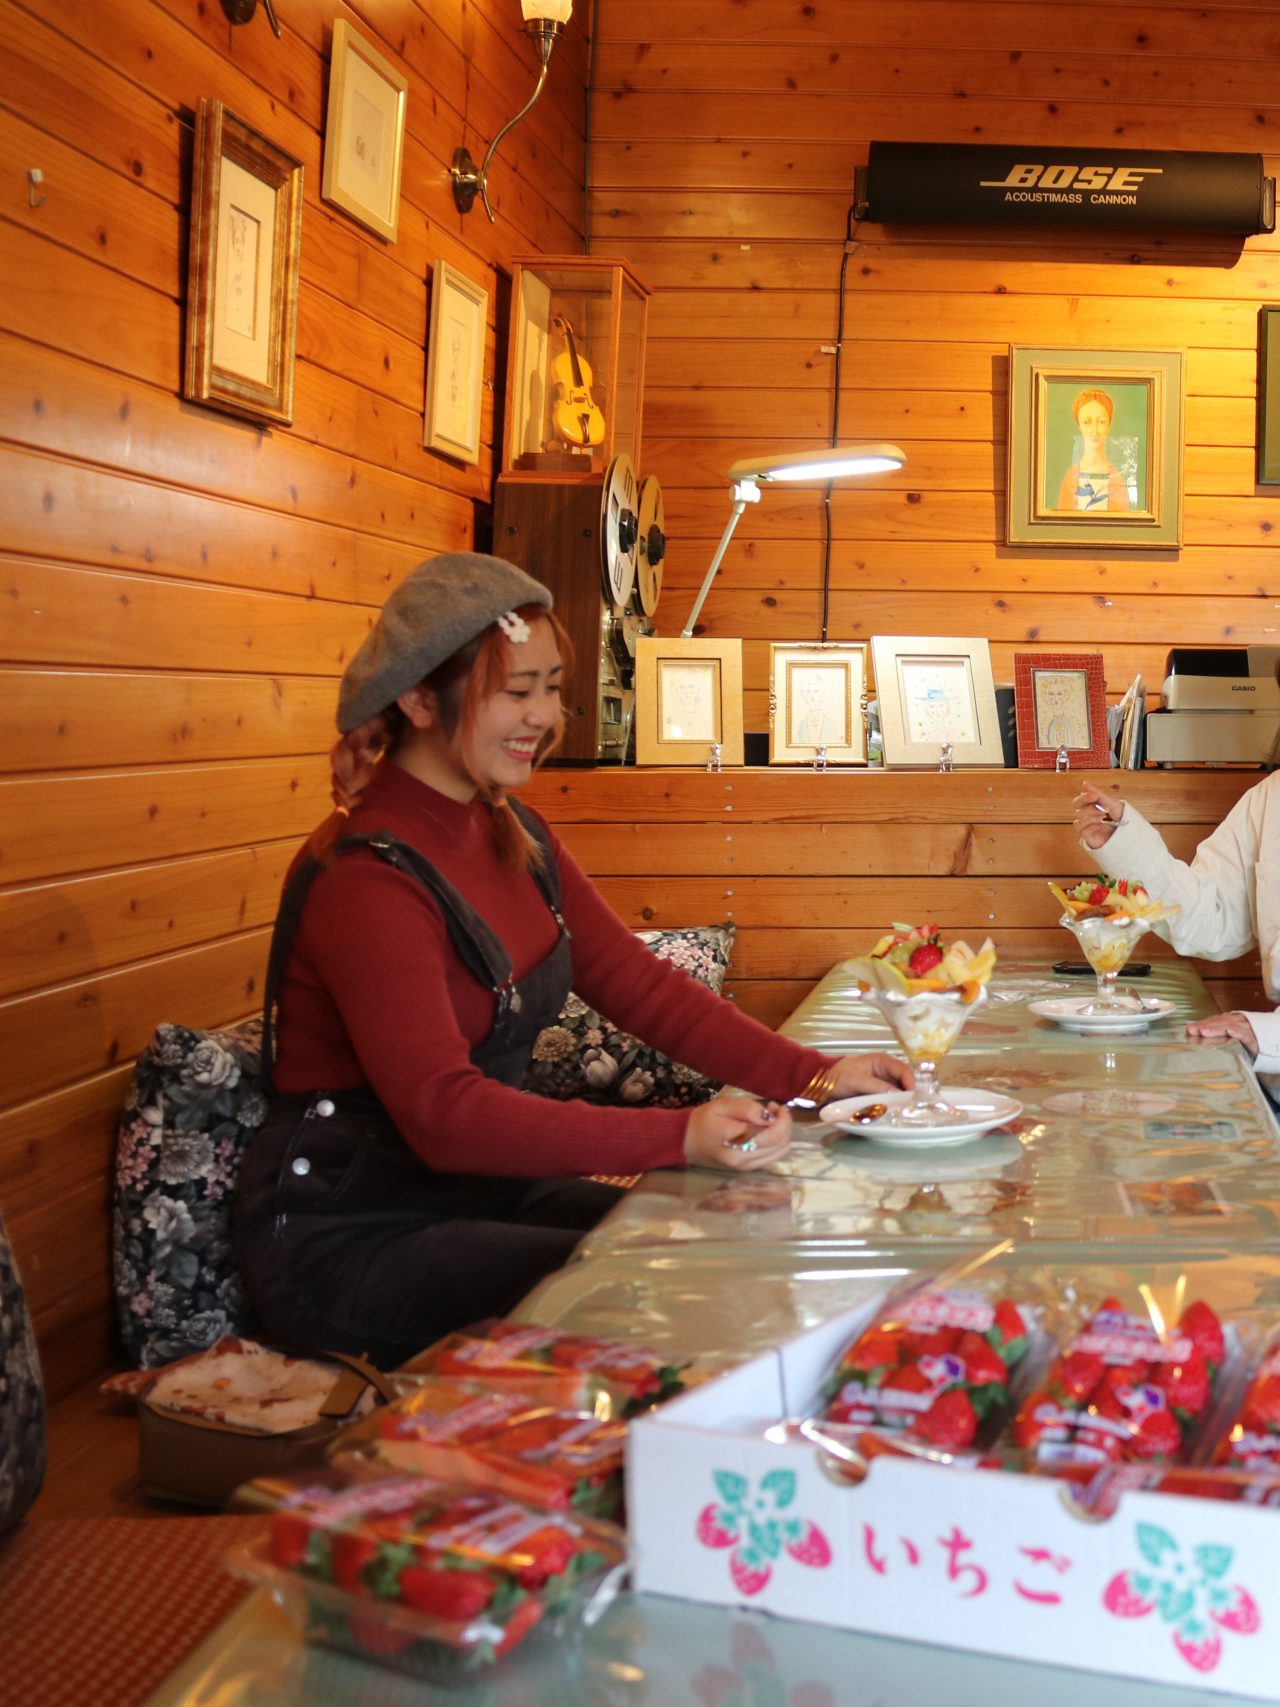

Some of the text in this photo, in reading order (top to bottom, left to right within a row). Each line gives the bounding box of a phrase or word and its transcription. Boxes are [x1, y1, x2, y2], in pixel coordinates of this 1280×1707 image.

[980, 164, 1163, 191] BOSE
[1004, 191, 1137, 205] ACOUSTIMASS CANNON
[862, 1521, 1072, 1605] いちご
